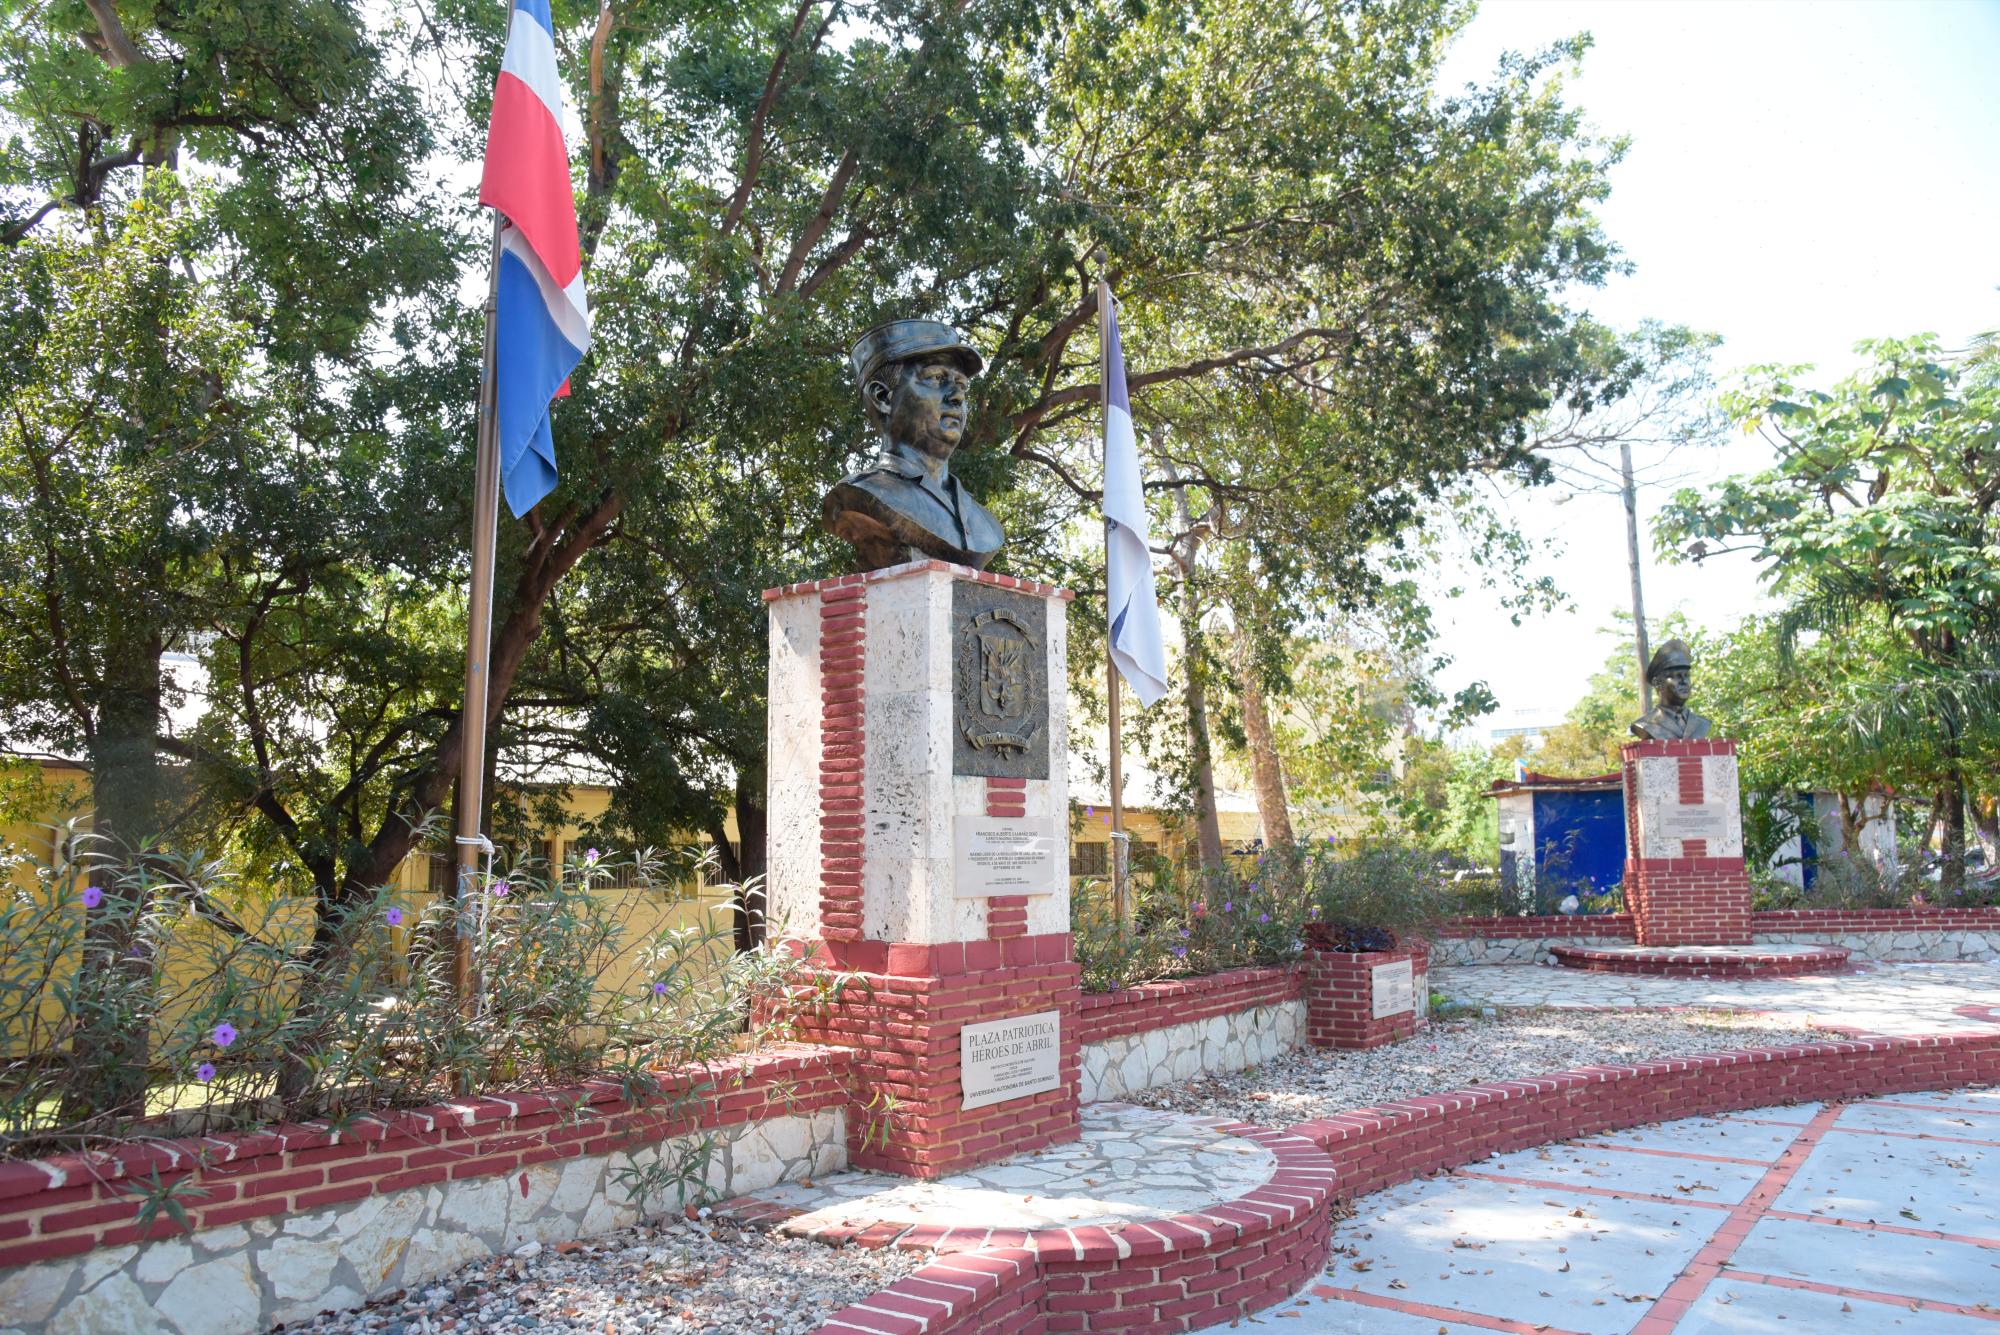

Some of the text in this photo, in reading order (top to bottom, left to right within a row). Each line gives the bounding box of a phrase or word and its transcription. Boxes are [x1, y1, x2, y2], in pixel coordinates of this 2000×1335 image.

[969, 1022, 1054, 1047] PLAZA PATRIOTICA
[1012, 1041, 1024, 1055] DE
[1025, 1037, 1053, 1053] ABRIL
